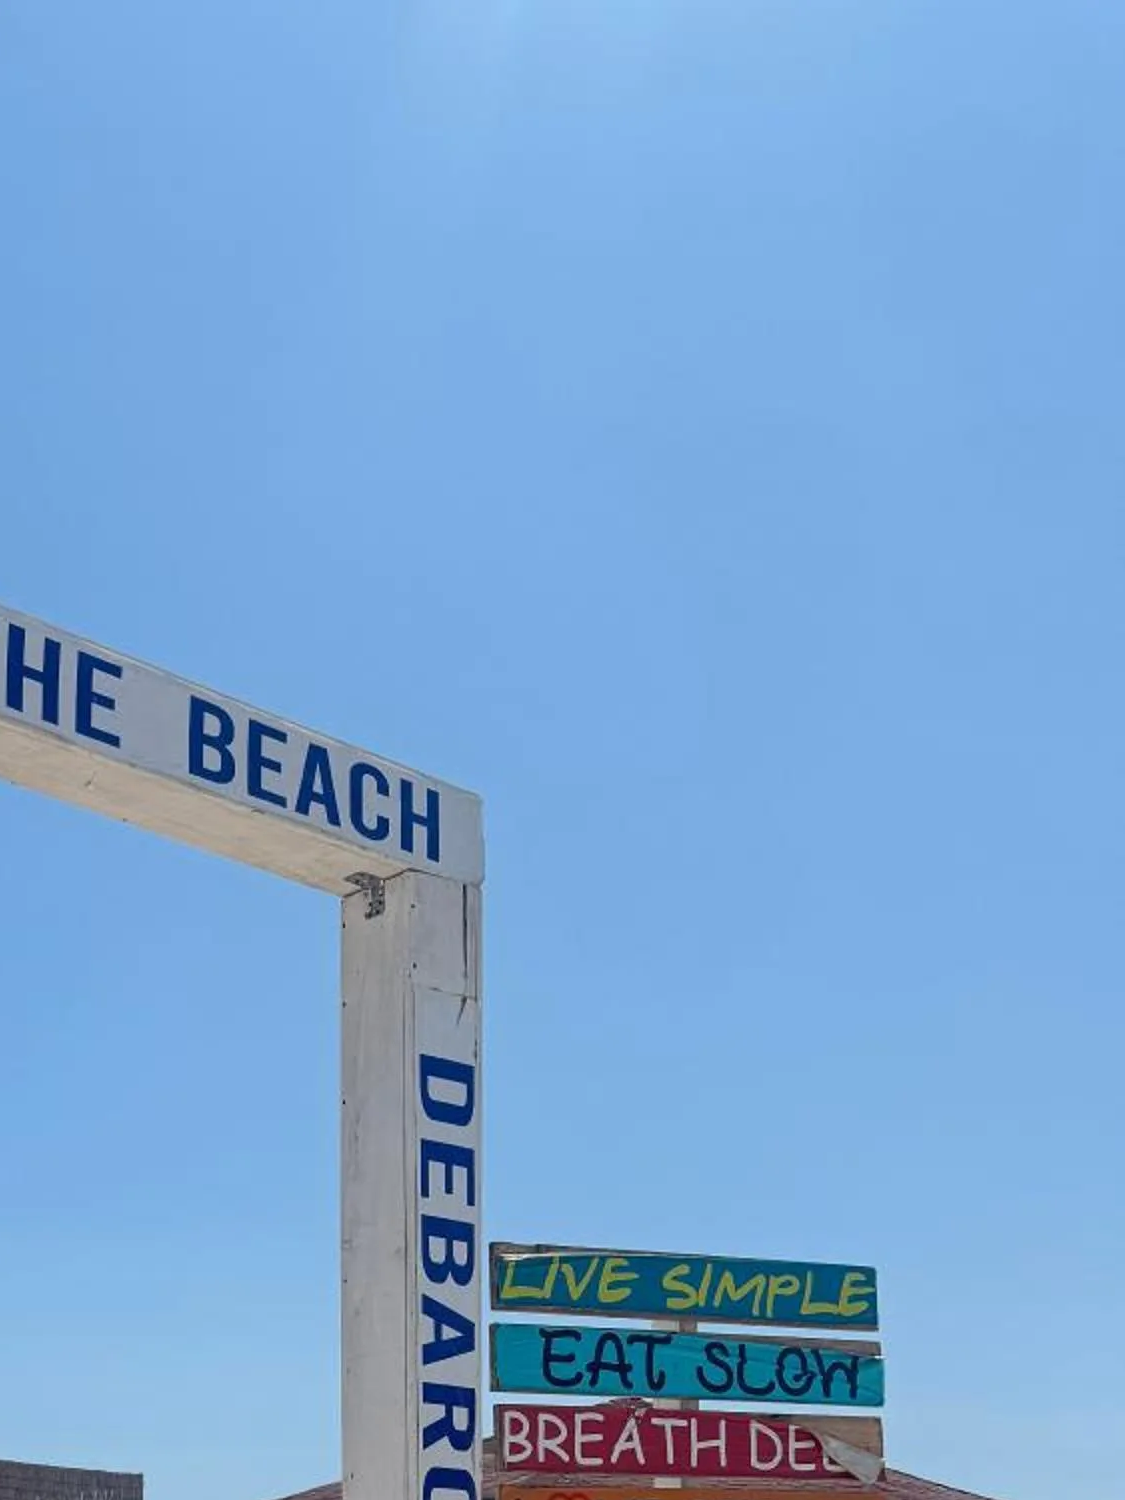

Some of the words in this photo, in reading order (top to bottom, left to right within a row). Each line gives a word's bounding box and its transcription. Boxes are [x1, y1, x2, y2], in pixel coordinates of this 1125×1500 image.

[188, 694, 441, 864] BEACH
[500, 1256, 639, 1303] LIVE
[661, 1263, 876, 1317] SIMPLE
[539, 1328, 678, 1391] EAT
[697, 1341, 860, 1399] SLOW
[503, 1411, 728, 1467] BREATH
